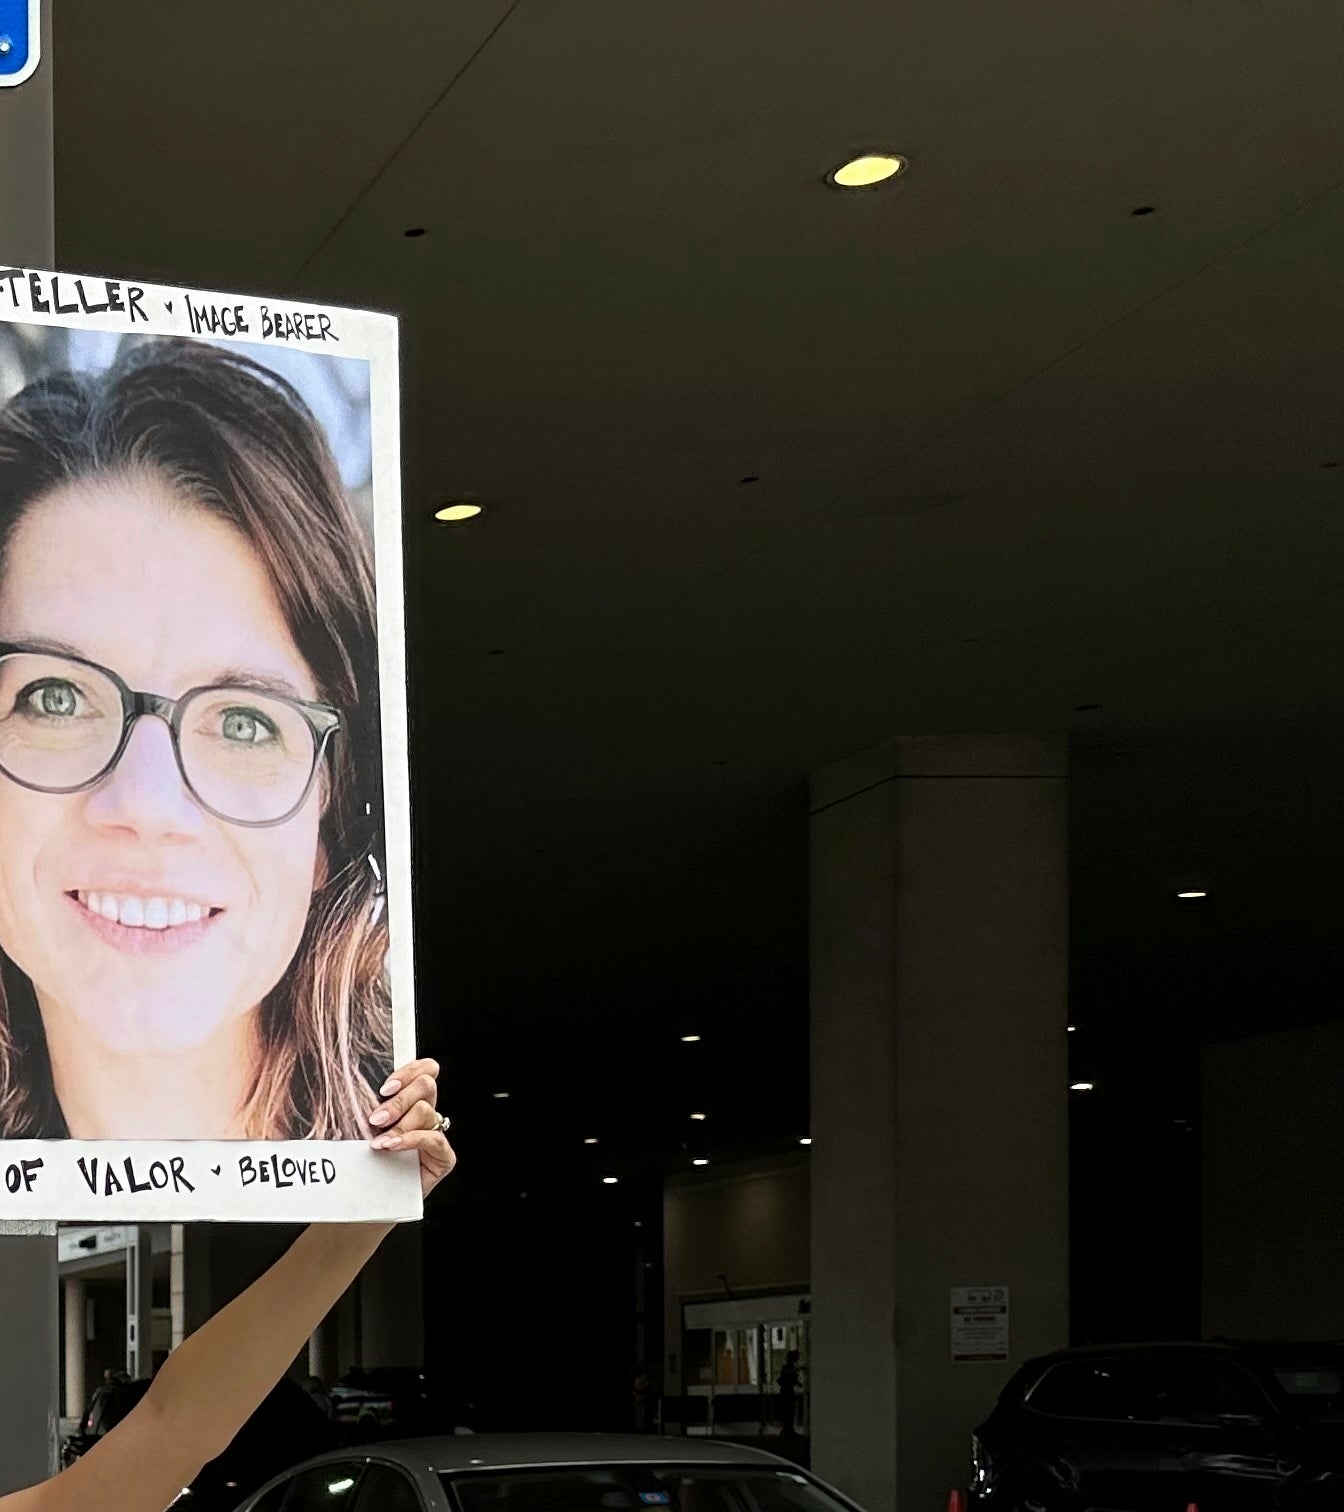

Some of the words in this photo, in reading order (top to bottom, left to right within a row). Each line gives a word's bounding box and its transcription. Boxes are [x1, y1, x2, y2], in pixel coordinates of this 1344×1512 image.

[184, 294, 249, 336] IMAGE
[260, 305, 340, 342] BEARER
[5, 1157, 44, 1194] OF
[76, 1156, 196, 1197] VALOR
[238, 1153, 336, 1189] BELOVED
